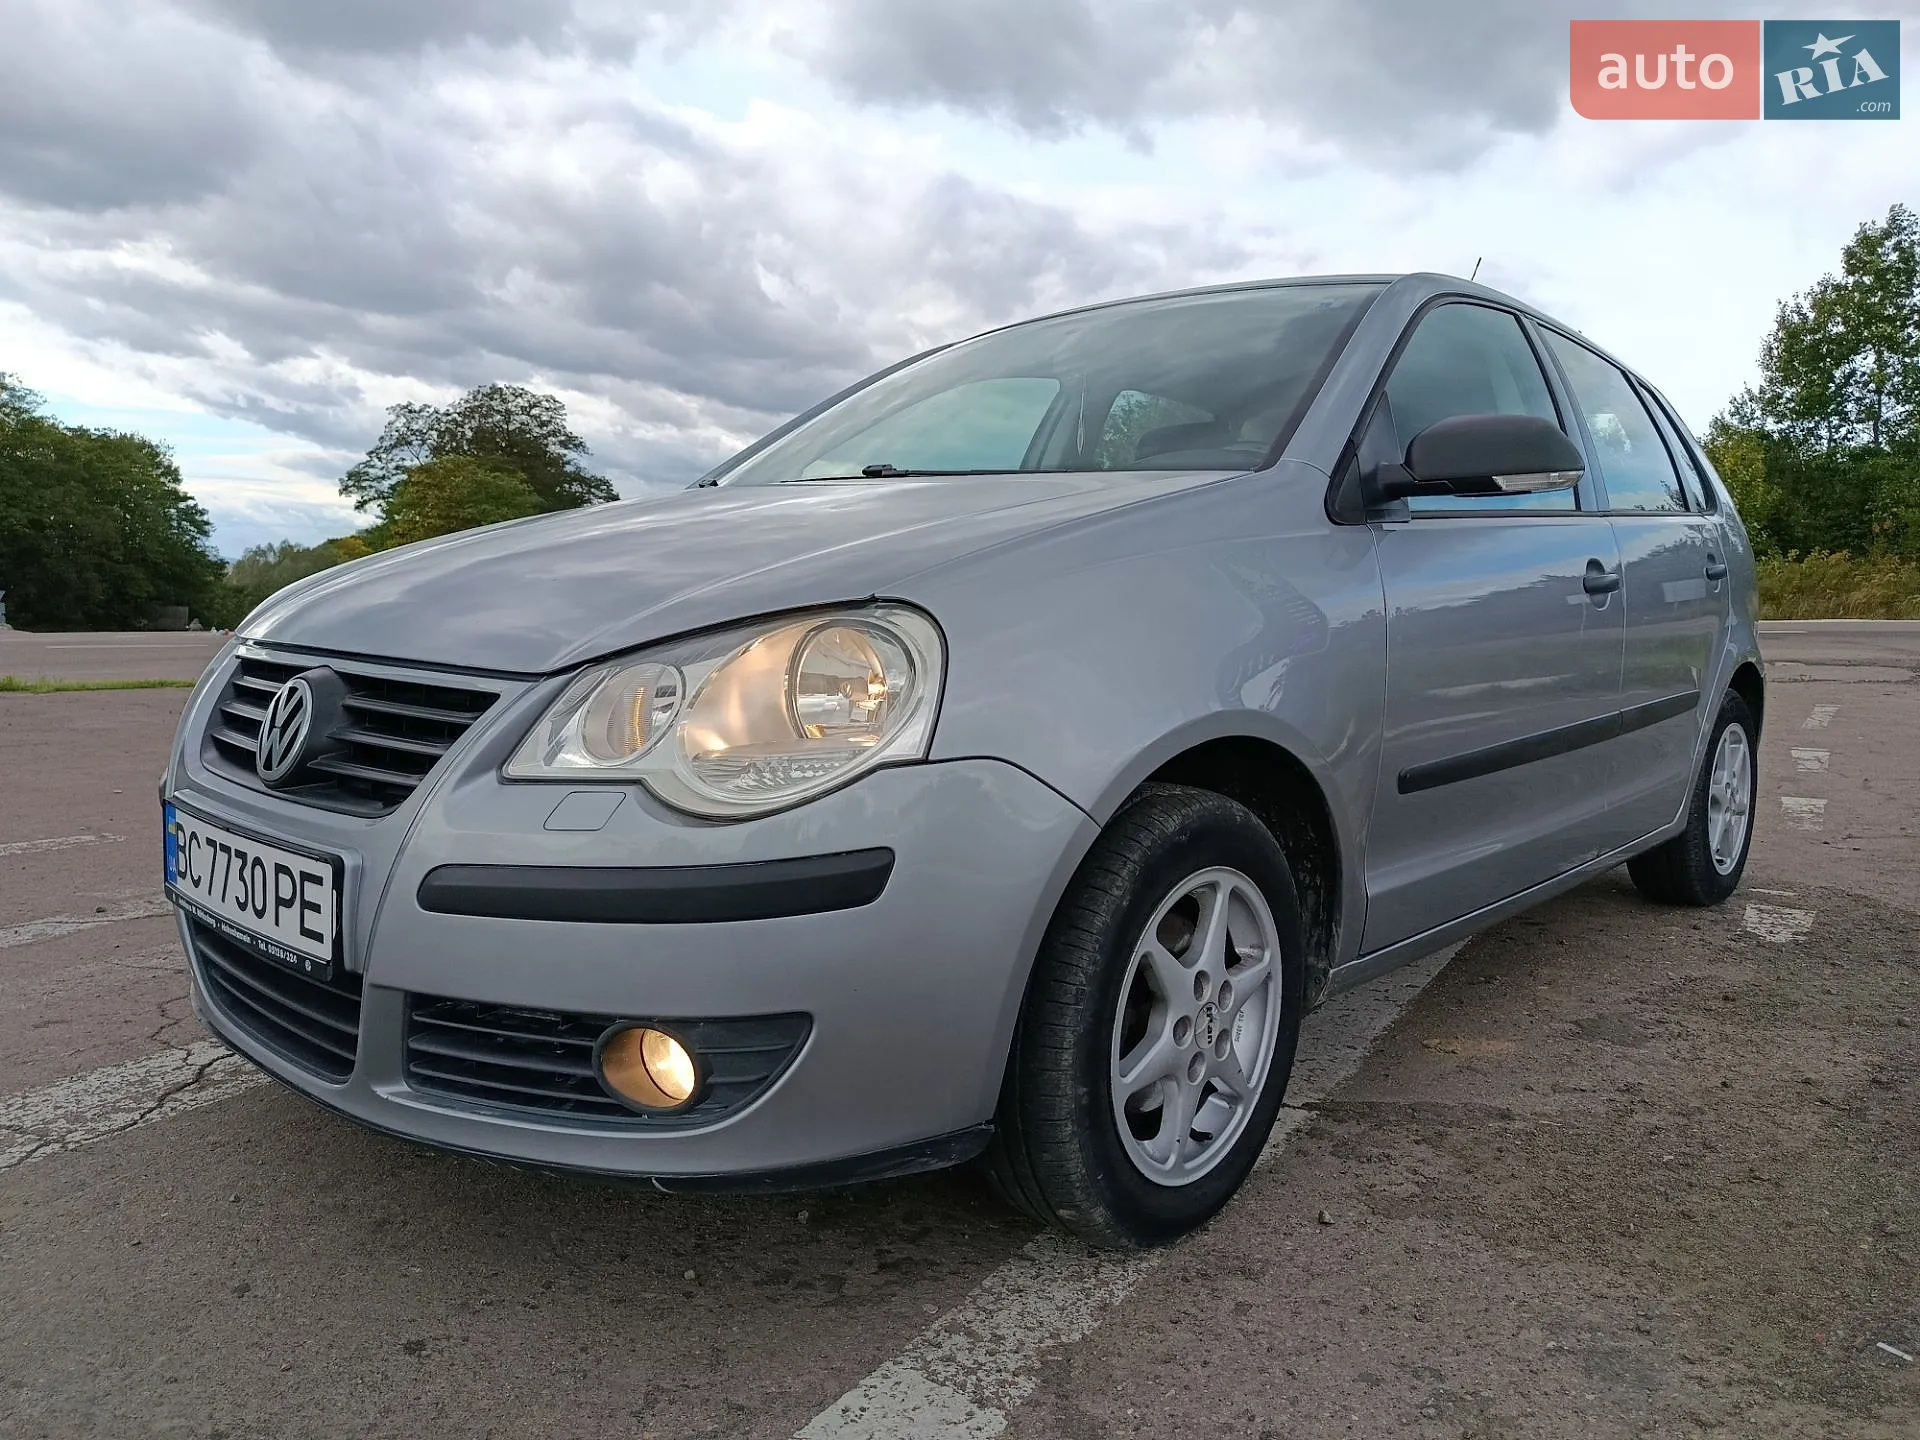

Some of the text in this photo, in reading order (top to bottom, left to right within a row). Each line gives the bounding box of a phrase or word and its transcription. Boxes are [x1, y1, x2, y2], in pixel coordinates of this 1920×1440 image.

[177, 821, 202, 889] BC
[205, 836, 267, 920] 7730
[274, 861, 324, 945] PE
